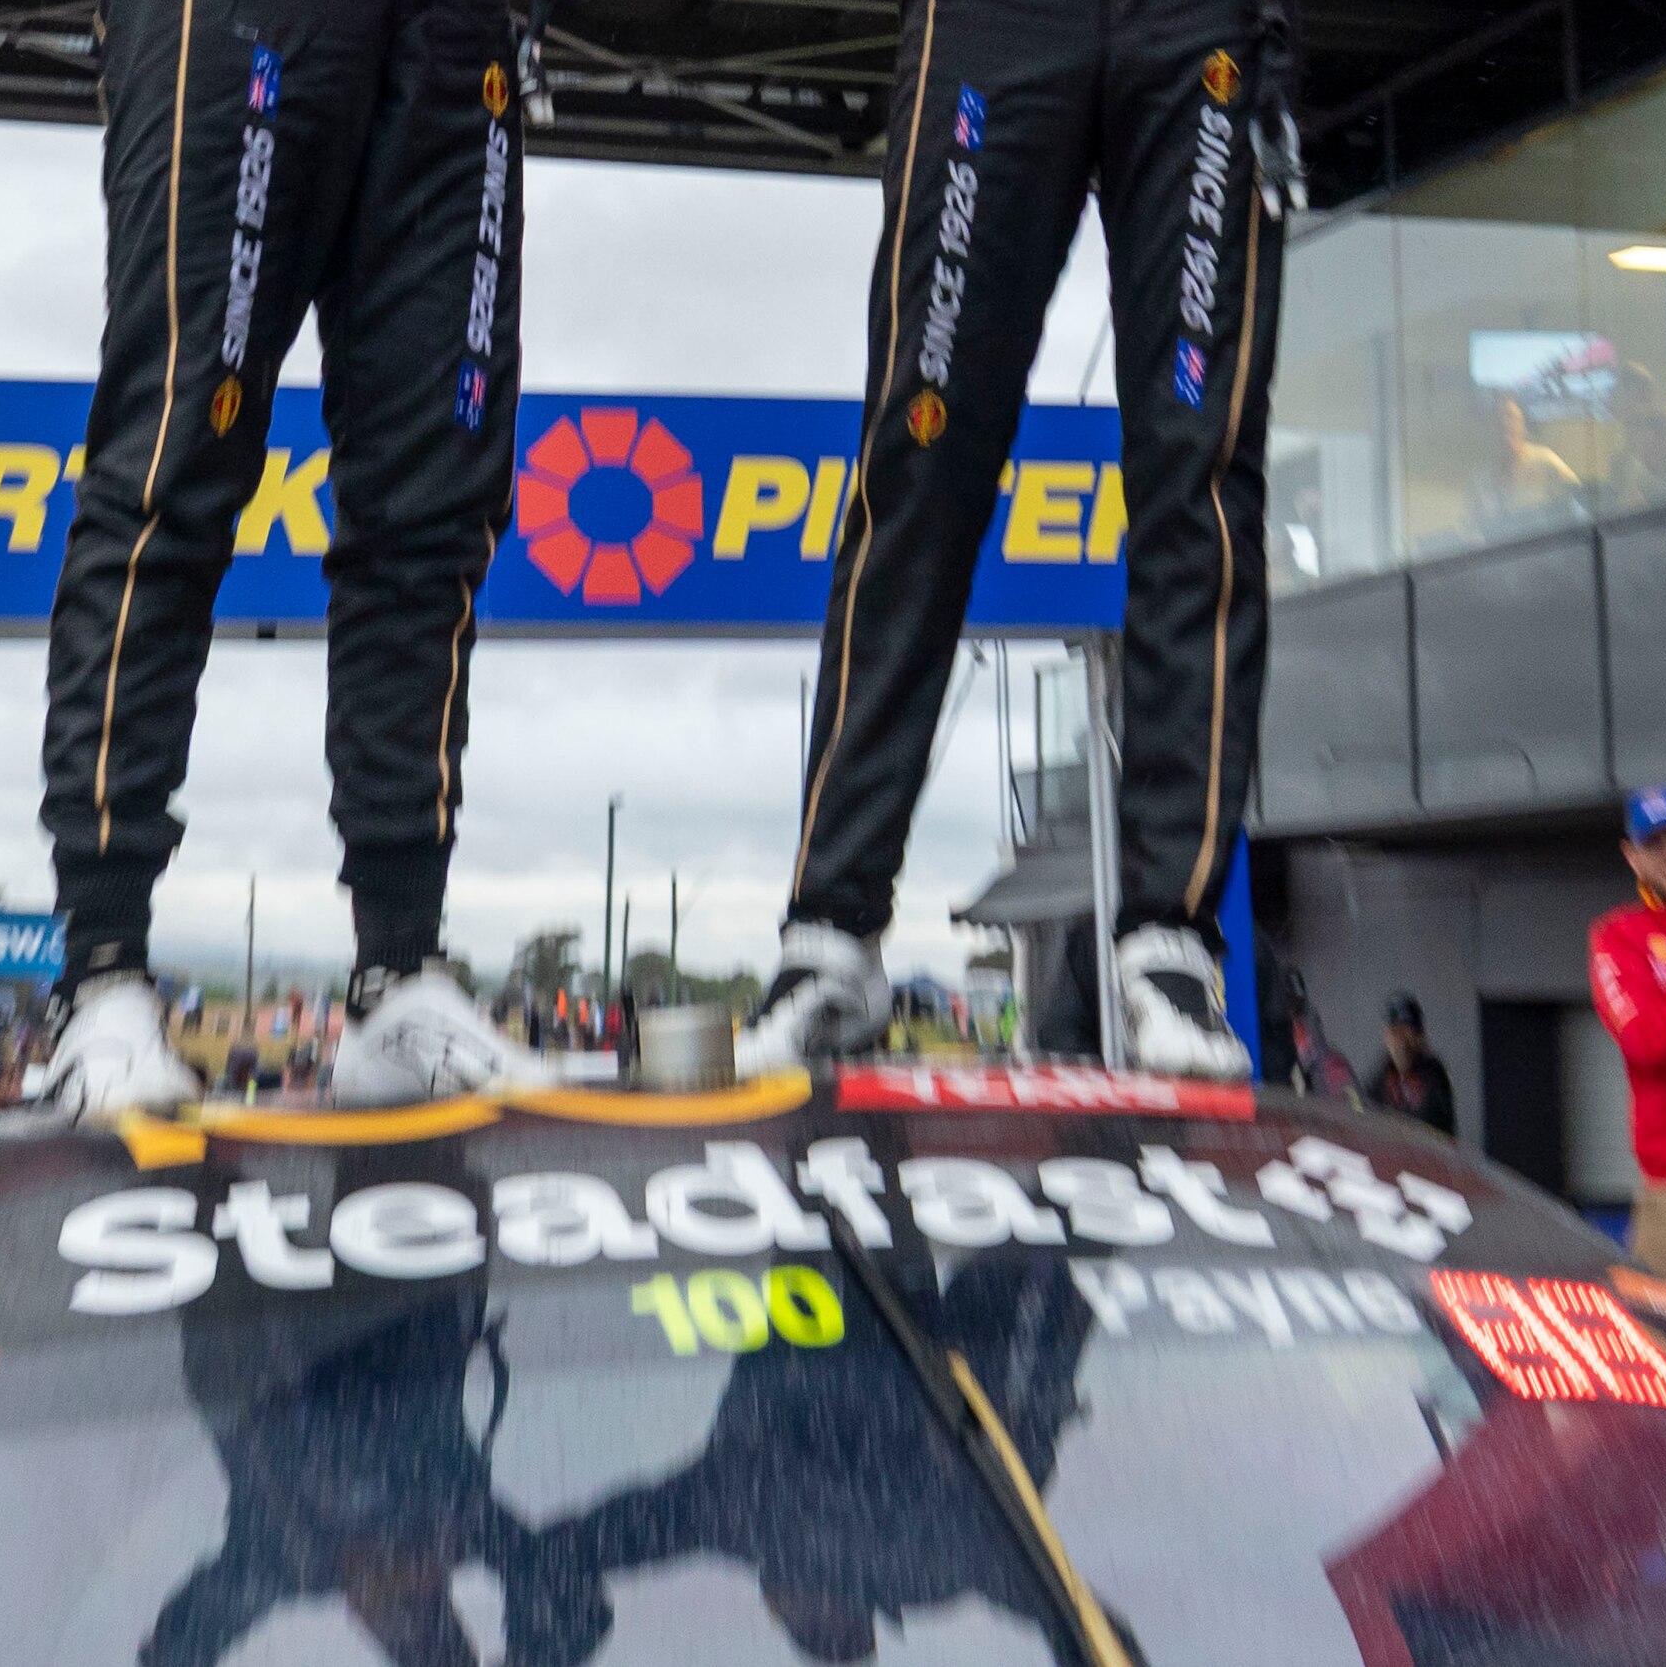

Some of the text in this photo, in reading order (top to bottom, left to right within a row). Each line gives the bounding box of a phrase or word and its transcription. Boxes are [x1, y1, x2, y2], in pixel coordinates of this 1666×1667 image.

[918, 158, 979, 388] SINCE 1926
[1179, 103, 1234, 335] SINCE 1926
[632, 1264, 845, 1357] 100
